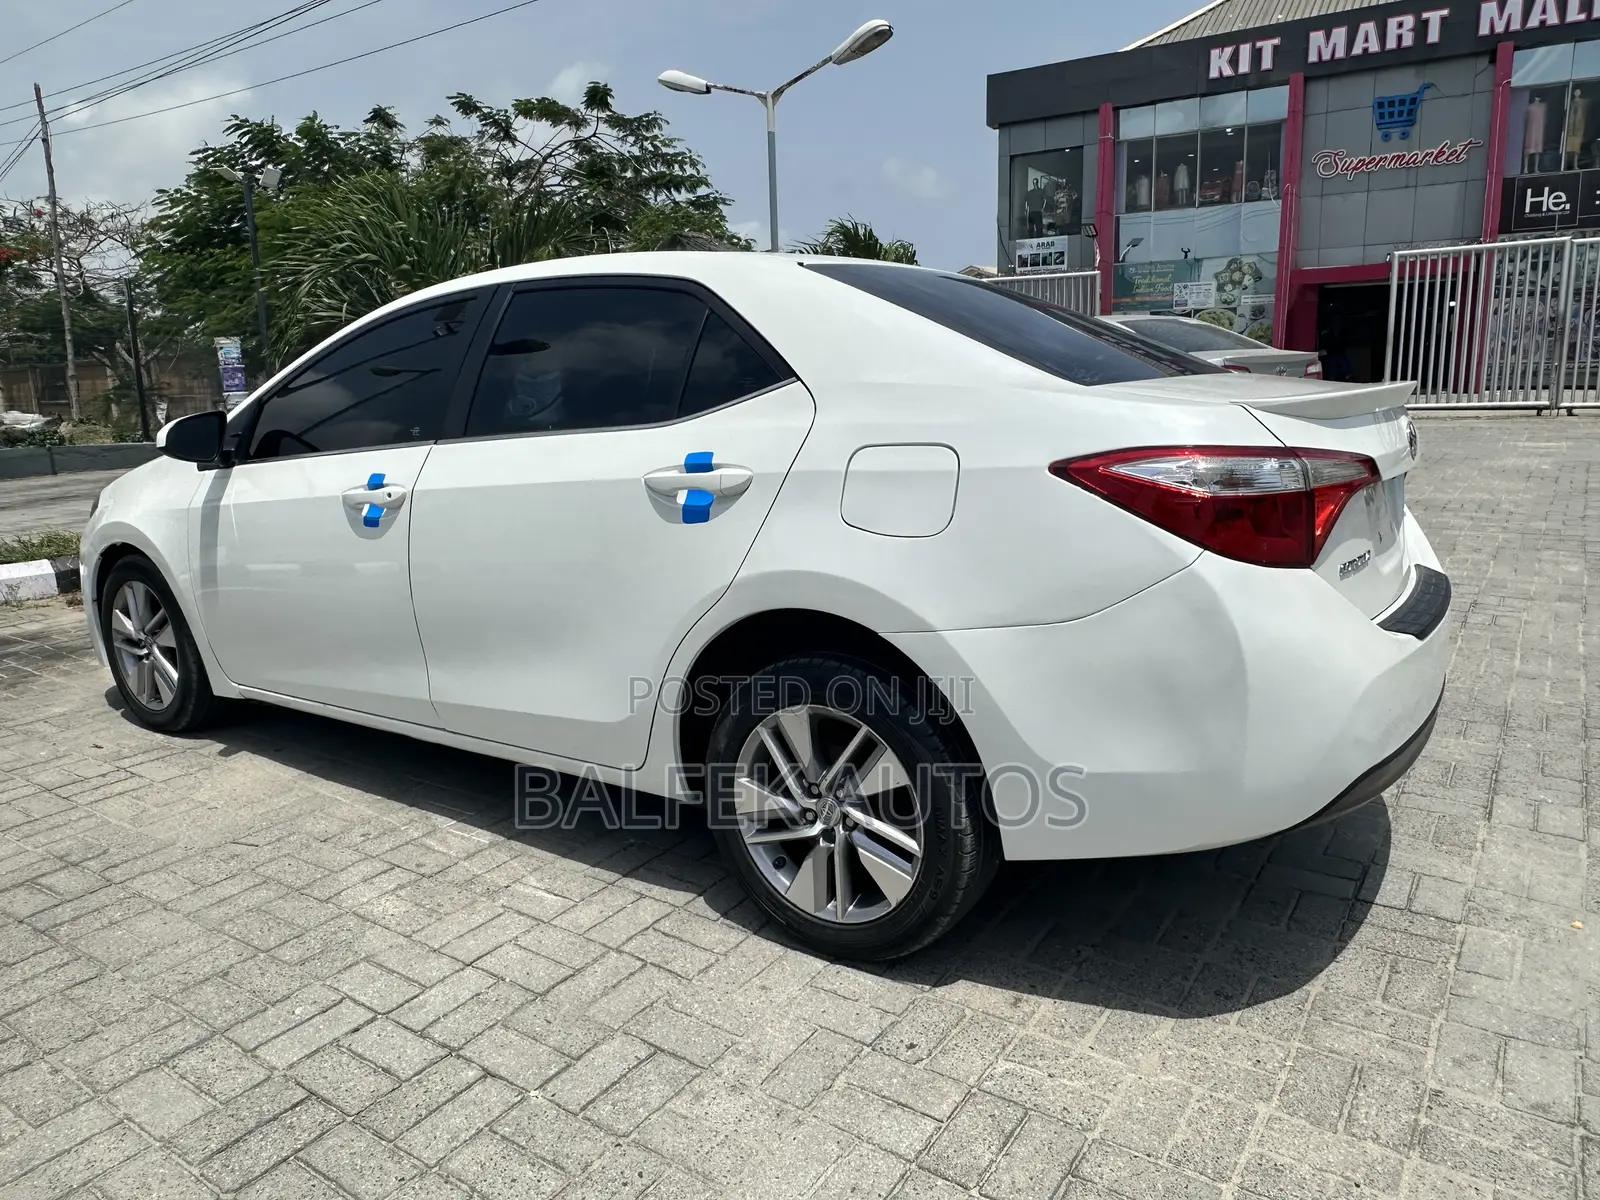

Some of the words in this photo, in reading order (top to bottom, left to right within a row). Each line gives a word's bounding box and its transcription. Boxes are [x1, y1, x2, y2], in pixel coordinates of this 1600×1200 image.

[1208, 37, 1281, 79] KIT
[1307, 8, 1449, 64] MART
[1312, 138, 1483, 180] Supermarket
[1525, 187, 1570, 213] He.
